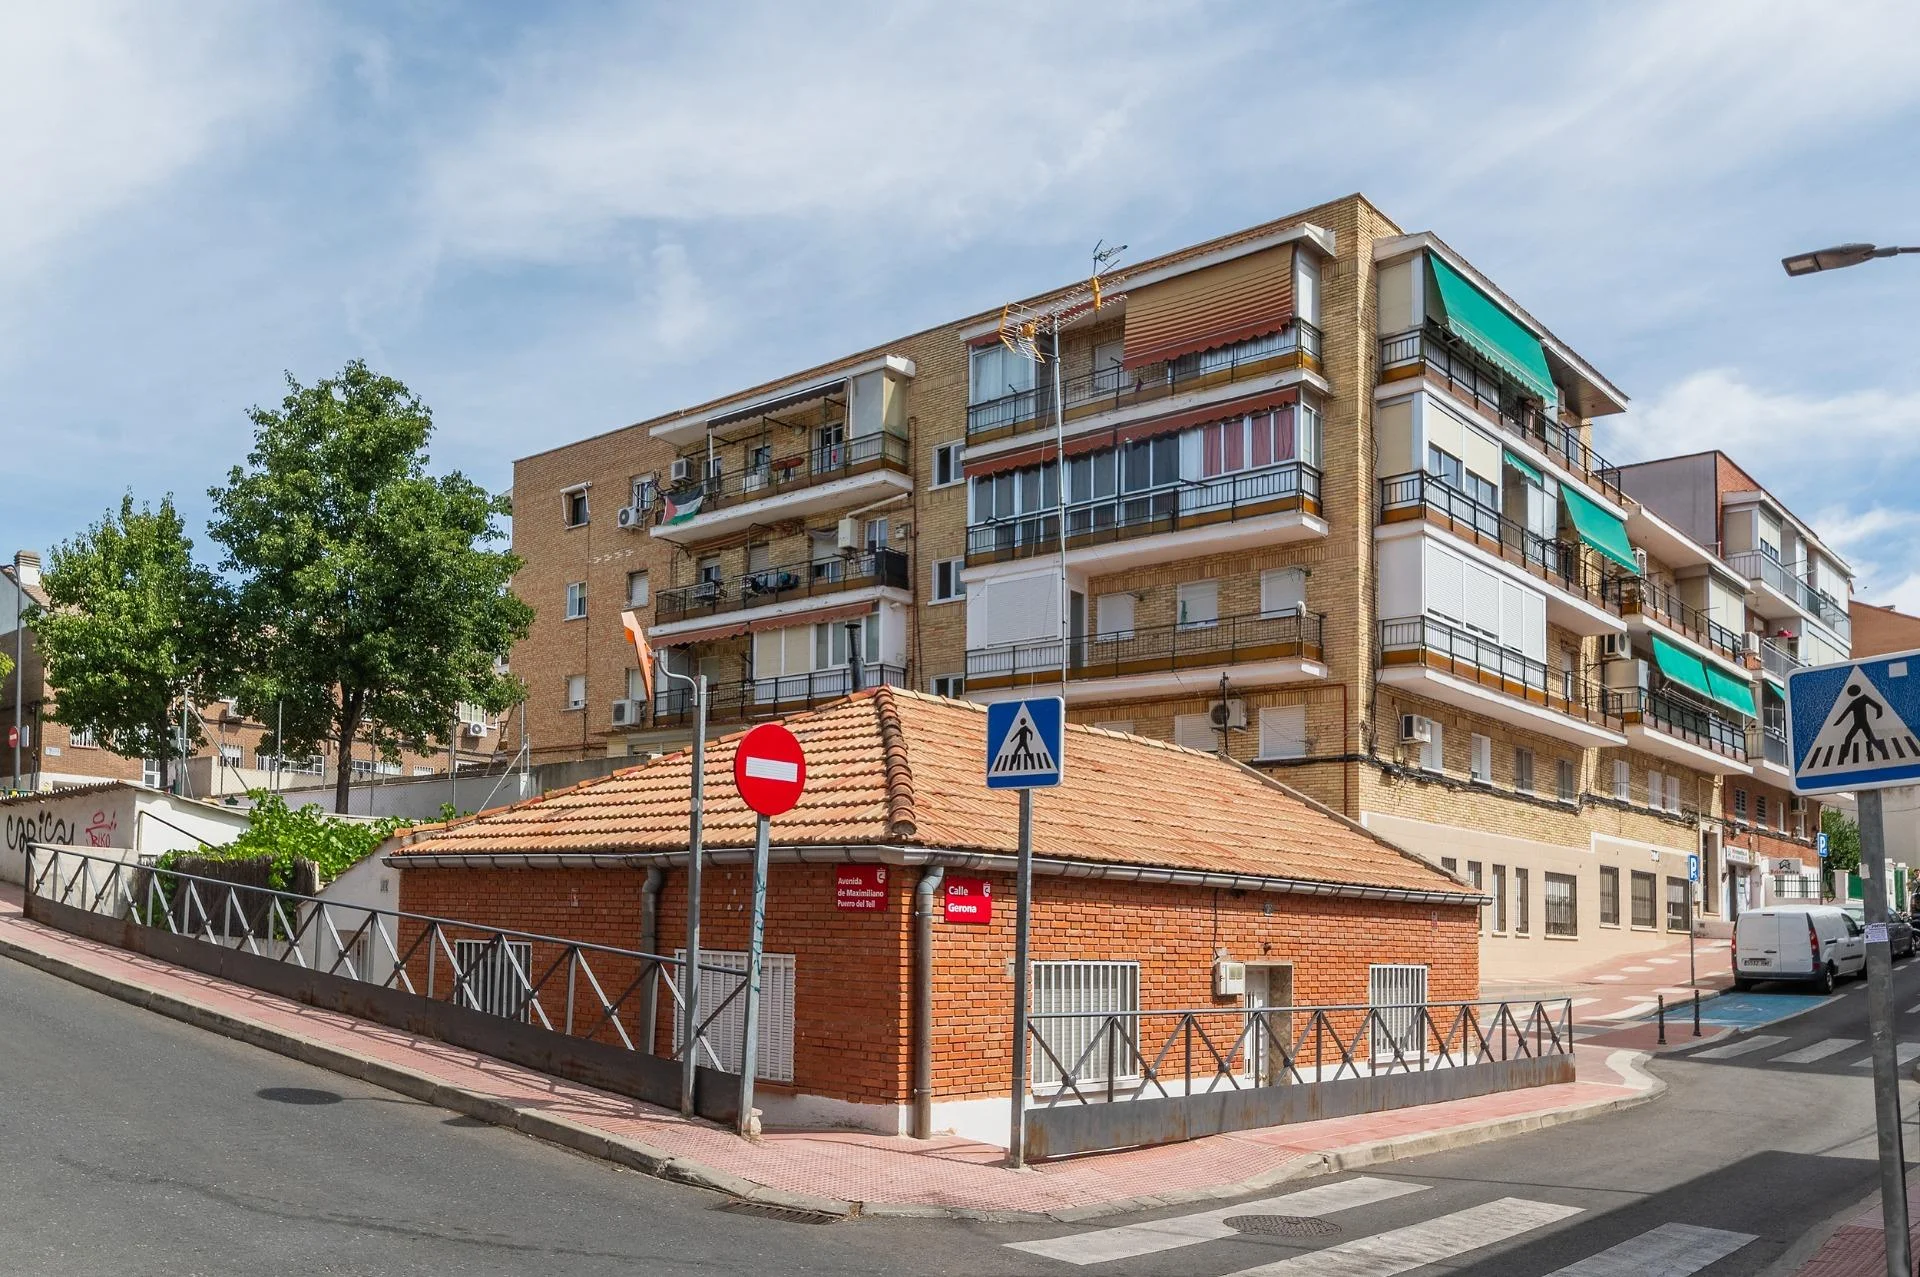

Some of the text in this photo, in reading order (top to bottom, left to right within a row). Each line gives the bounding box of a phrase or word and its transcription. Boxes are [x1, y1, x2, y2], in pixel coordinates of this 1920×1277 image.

[838, 877, 863, 885] Avenida
[837, 889, 884, 898] de Maximiliano
[948, 886, 969, 896] Calle
[856, 900, 865, 908] del
[866, 900, 876, 908] Tell
[947, 903, 977, 913] Gerona
